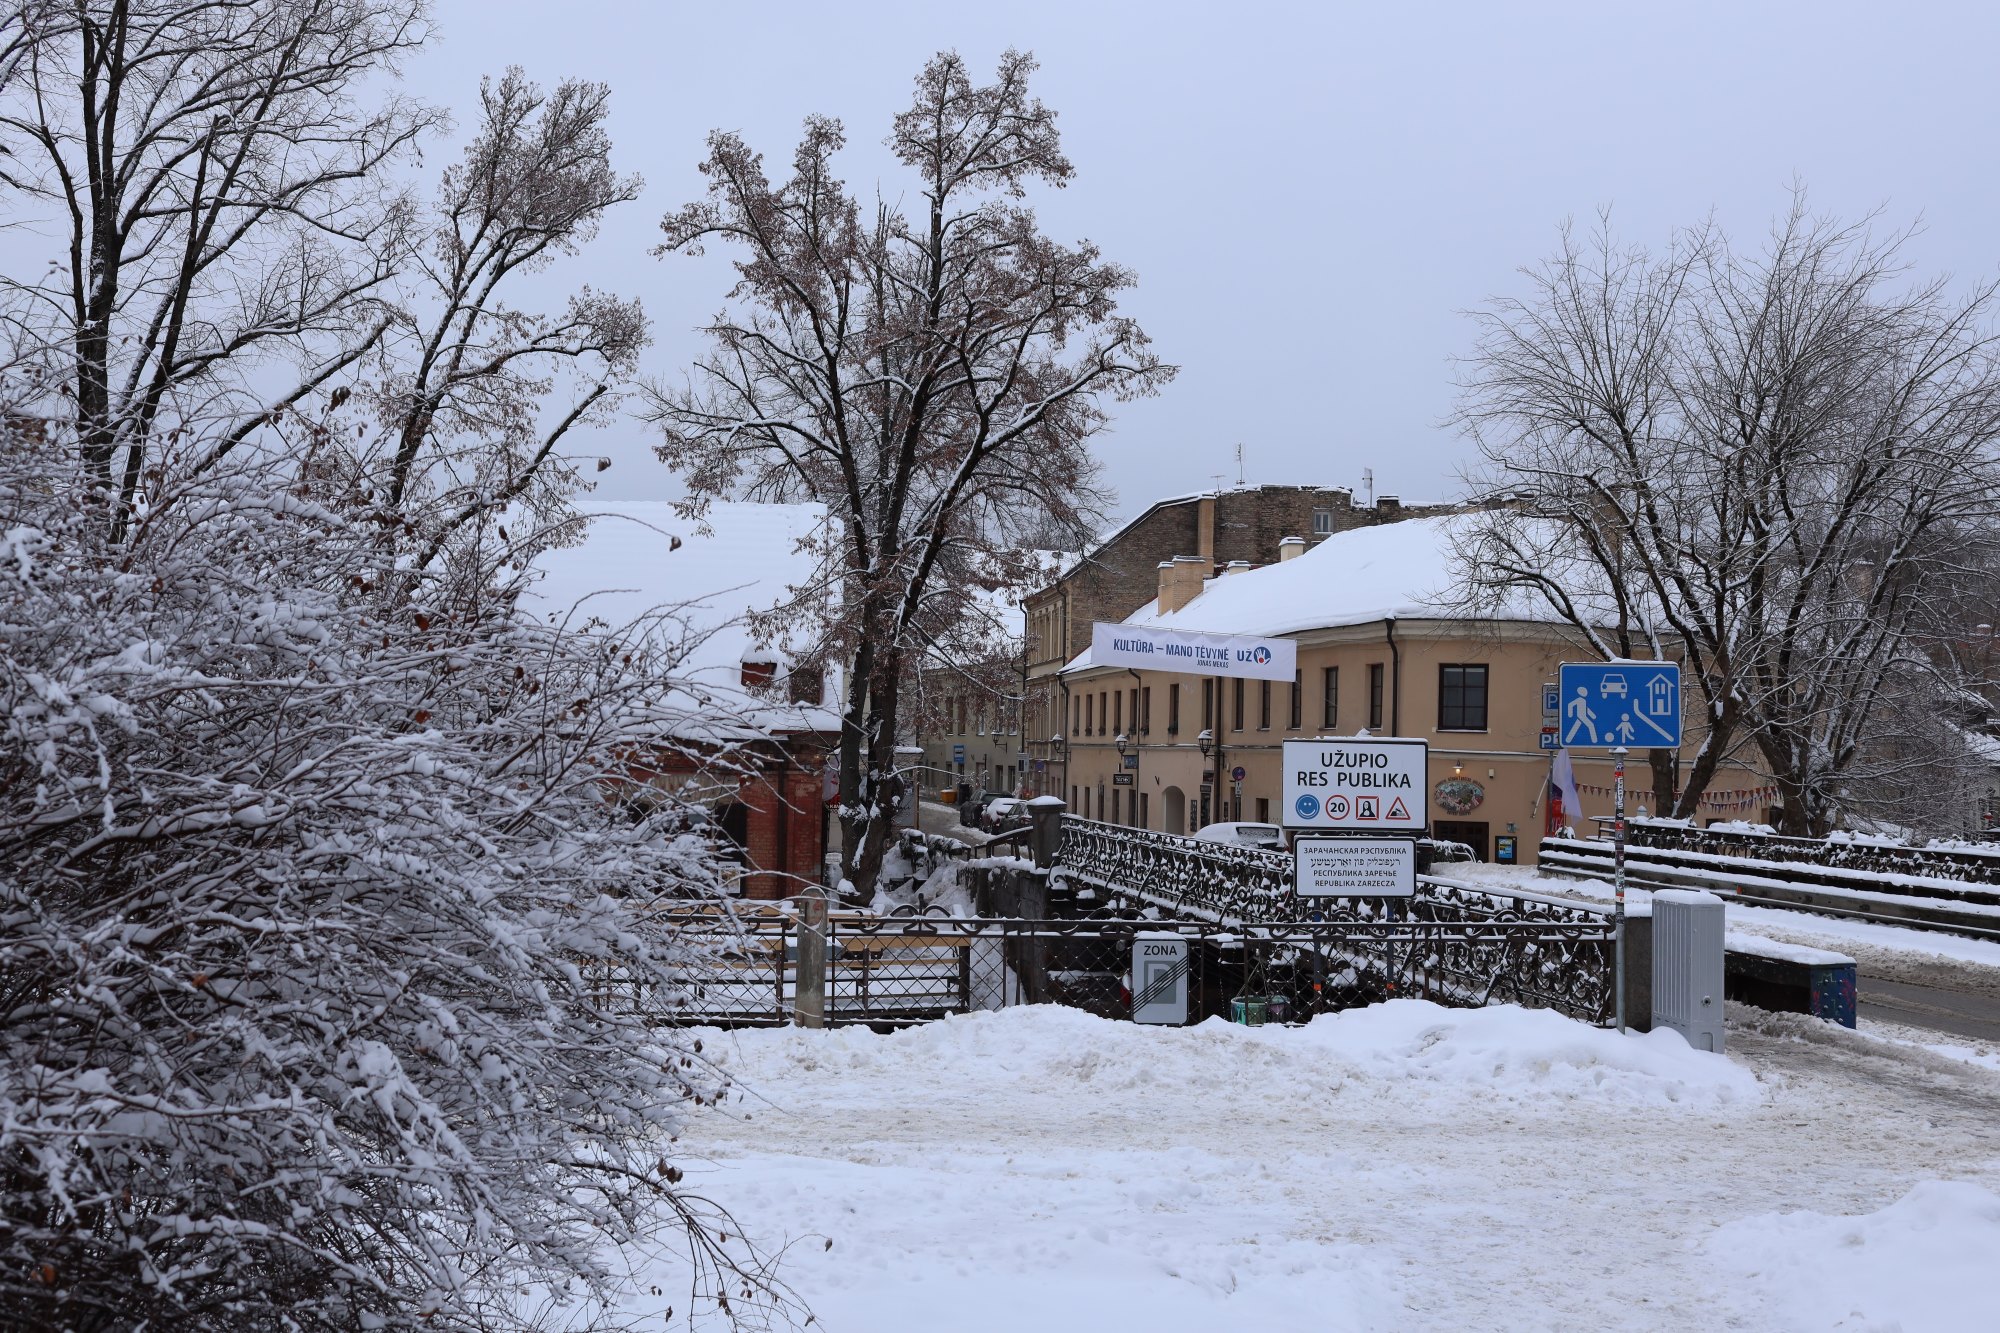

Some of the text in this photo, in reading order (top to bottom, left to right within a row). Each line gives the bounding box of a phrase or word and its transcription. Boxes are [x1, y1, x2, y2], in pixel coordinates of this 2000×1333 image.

[1113, 638, 1154, 654] KULTŪRA
[1165, 643, 1193, 657] MANO
[1195, 645, 1229, 660] TĖVYNĖ
[1196, 659, 1229, 668] JONAS MEKAS
[1547, 693, 1558, 709] P
[1541, 734, 1552, 749] P
[1321, 749, 1388, 768] UŽUPIO
[1297, 771, 1411, 788] RES PUBLIKA
[1330, 802, 1346, 813] 20
[1143, 945, 1178, 956] ZONA
